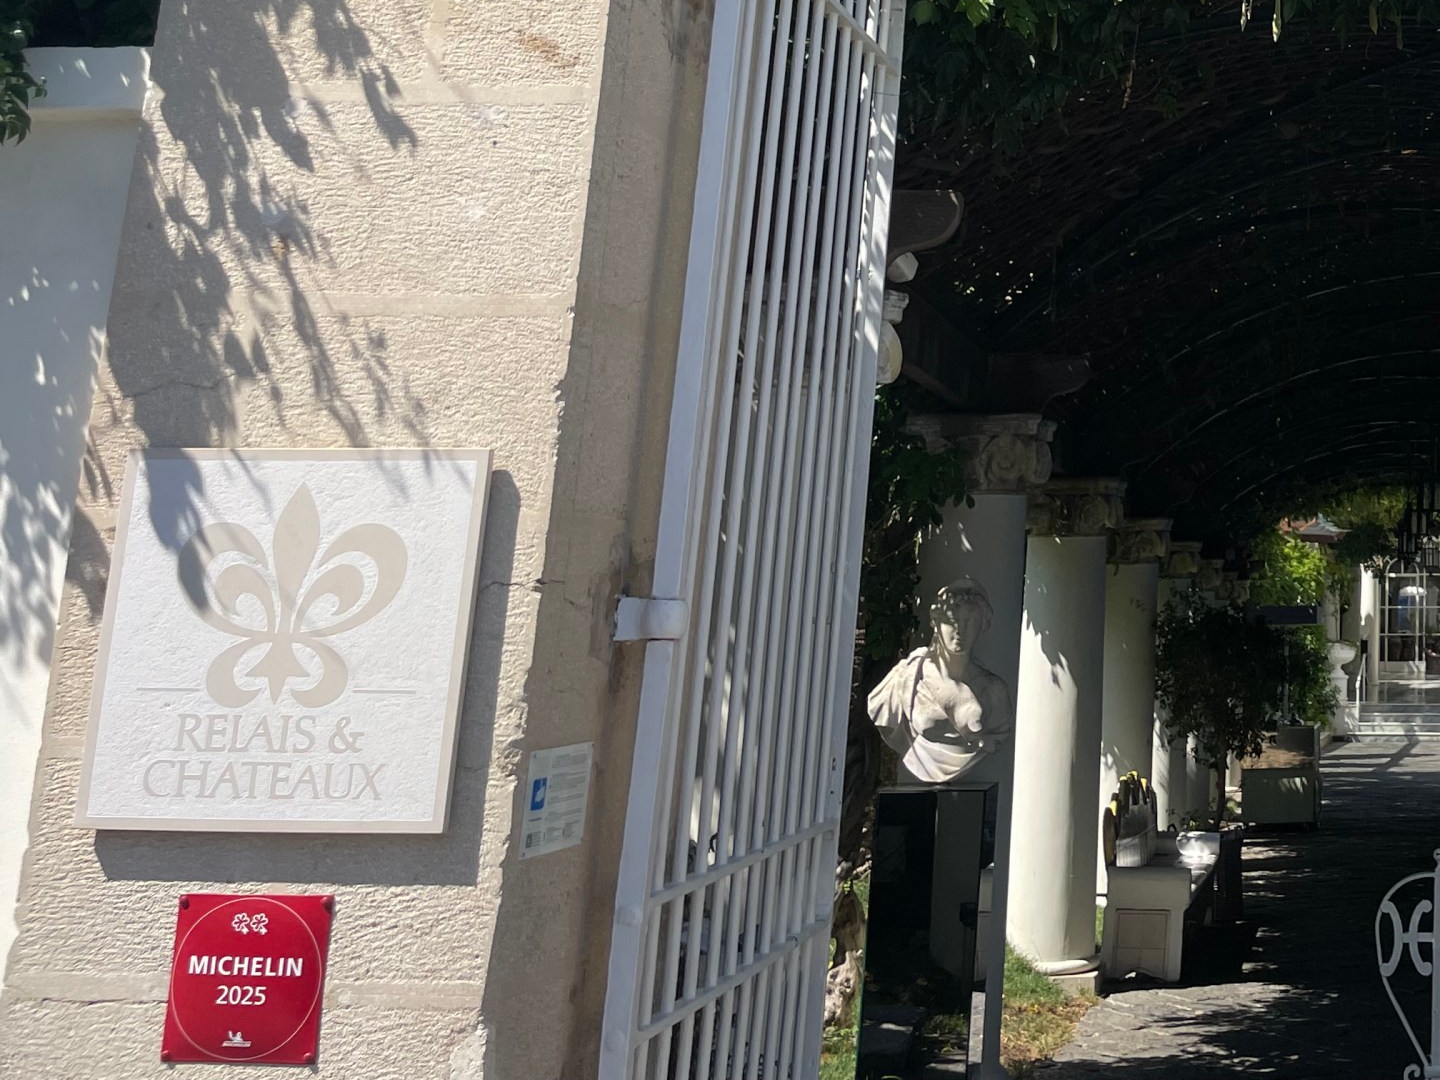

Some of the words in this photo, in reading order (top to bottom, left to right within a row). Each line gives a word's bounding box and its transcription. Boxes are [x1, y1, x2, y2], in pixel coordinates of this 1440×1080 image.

[172, 713, 318, 754] RELAIS
[328, 715, 366, 754] &
[143, 759, 387, 800] CHATEAUX
[188, 955, 303, 977] MICHELIN
[215, 985, 267, 1006] 2025
